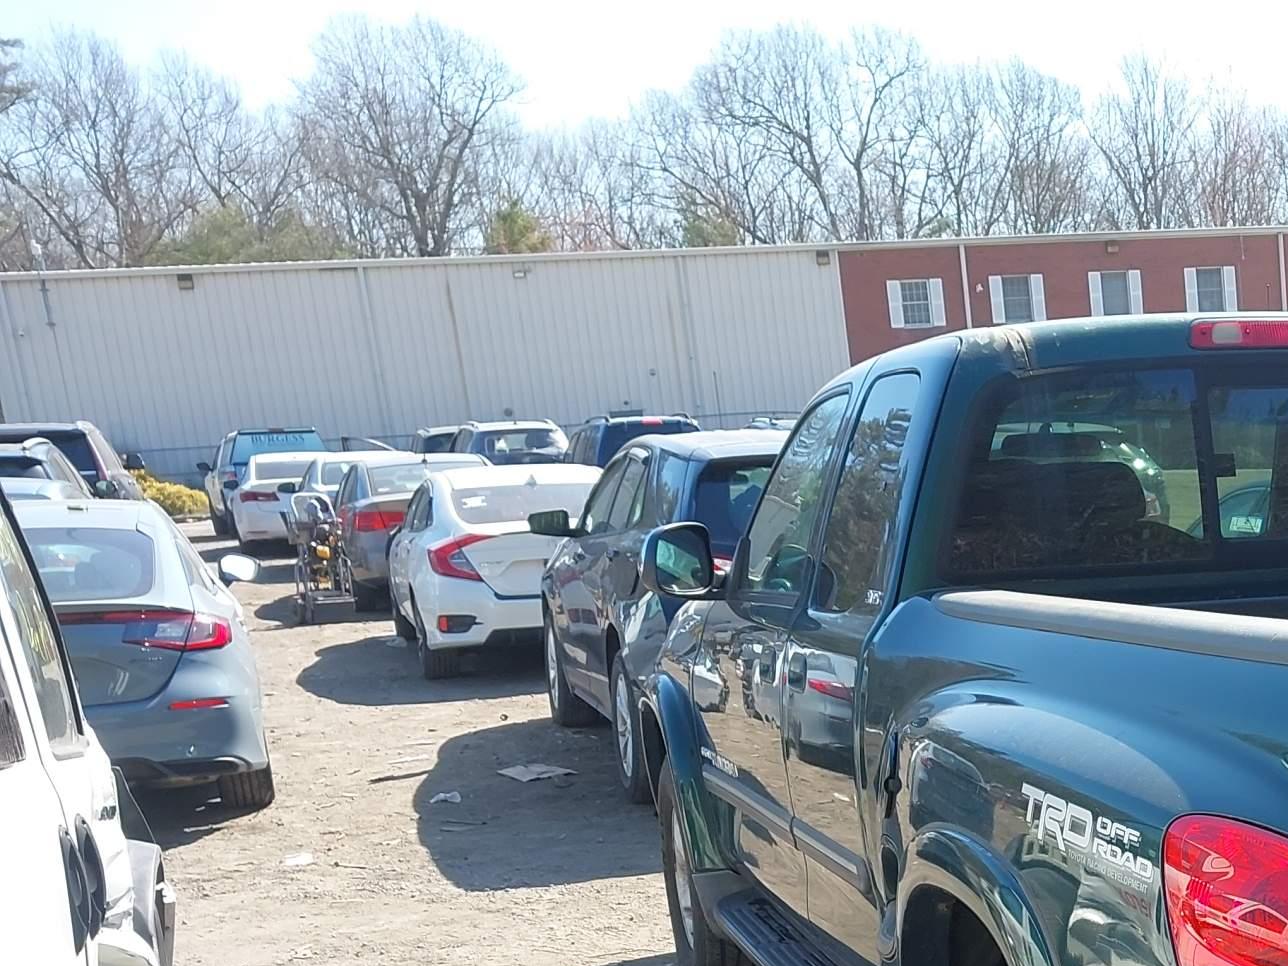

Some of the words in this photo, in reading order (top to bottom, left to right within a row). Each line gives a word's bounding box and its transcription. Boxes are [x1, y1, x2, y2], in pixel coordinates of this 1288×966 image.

[1021, 782, 1093, 852] TRD
[1096, 816, 1141, 846] OFF
[1093, 837, 1153, 880] ROAD
[1106, 868, 1148, 894] DEVELOPMENT
